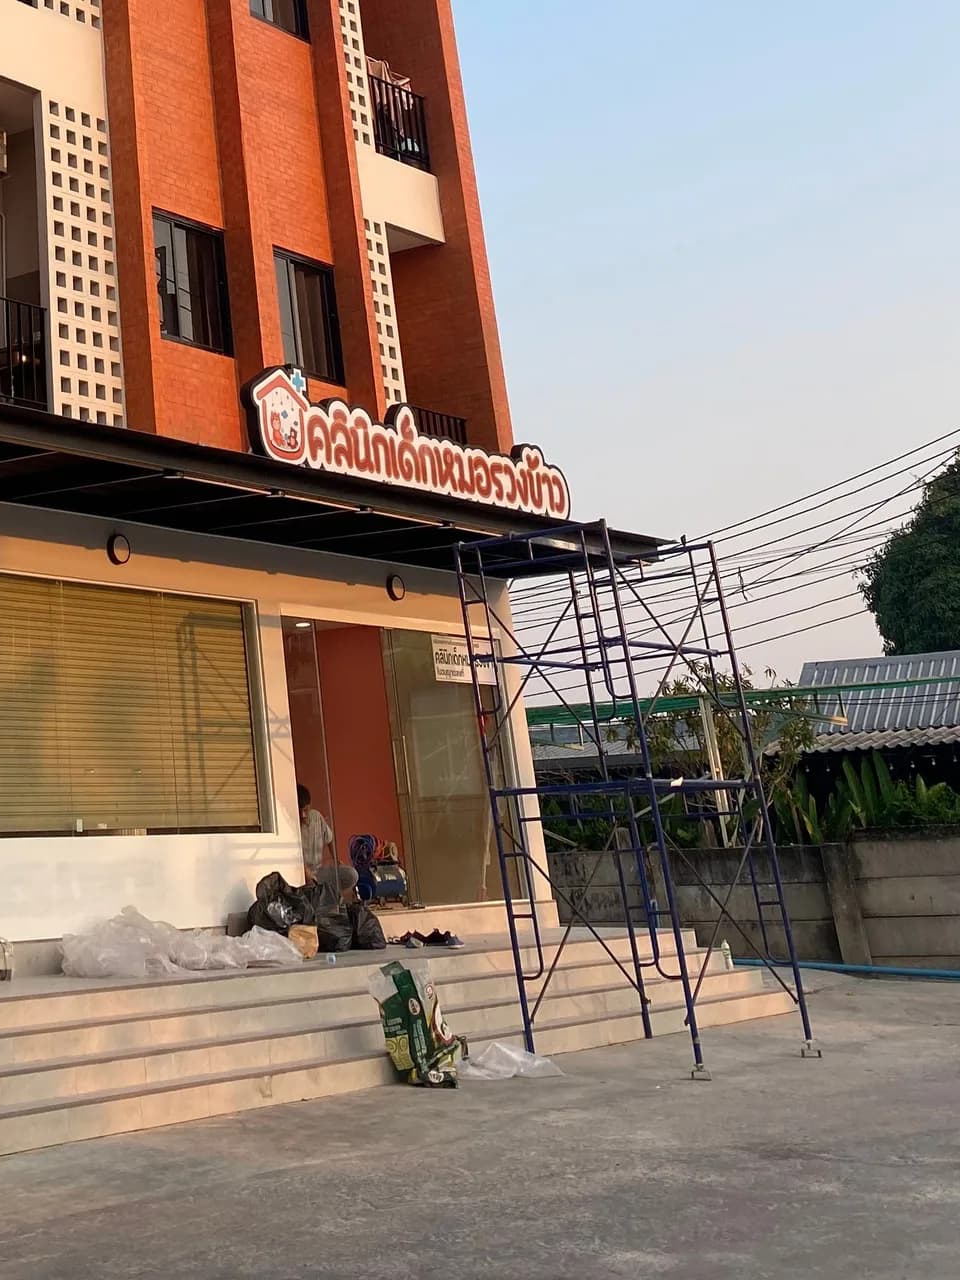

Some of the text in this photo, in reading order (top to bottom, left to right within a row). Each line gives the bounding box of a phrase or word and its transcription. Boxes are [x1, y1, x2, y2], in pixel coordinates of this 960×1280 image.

[307, 409, 565, 513] คลินิกเด็กหมอรวงข้าว
